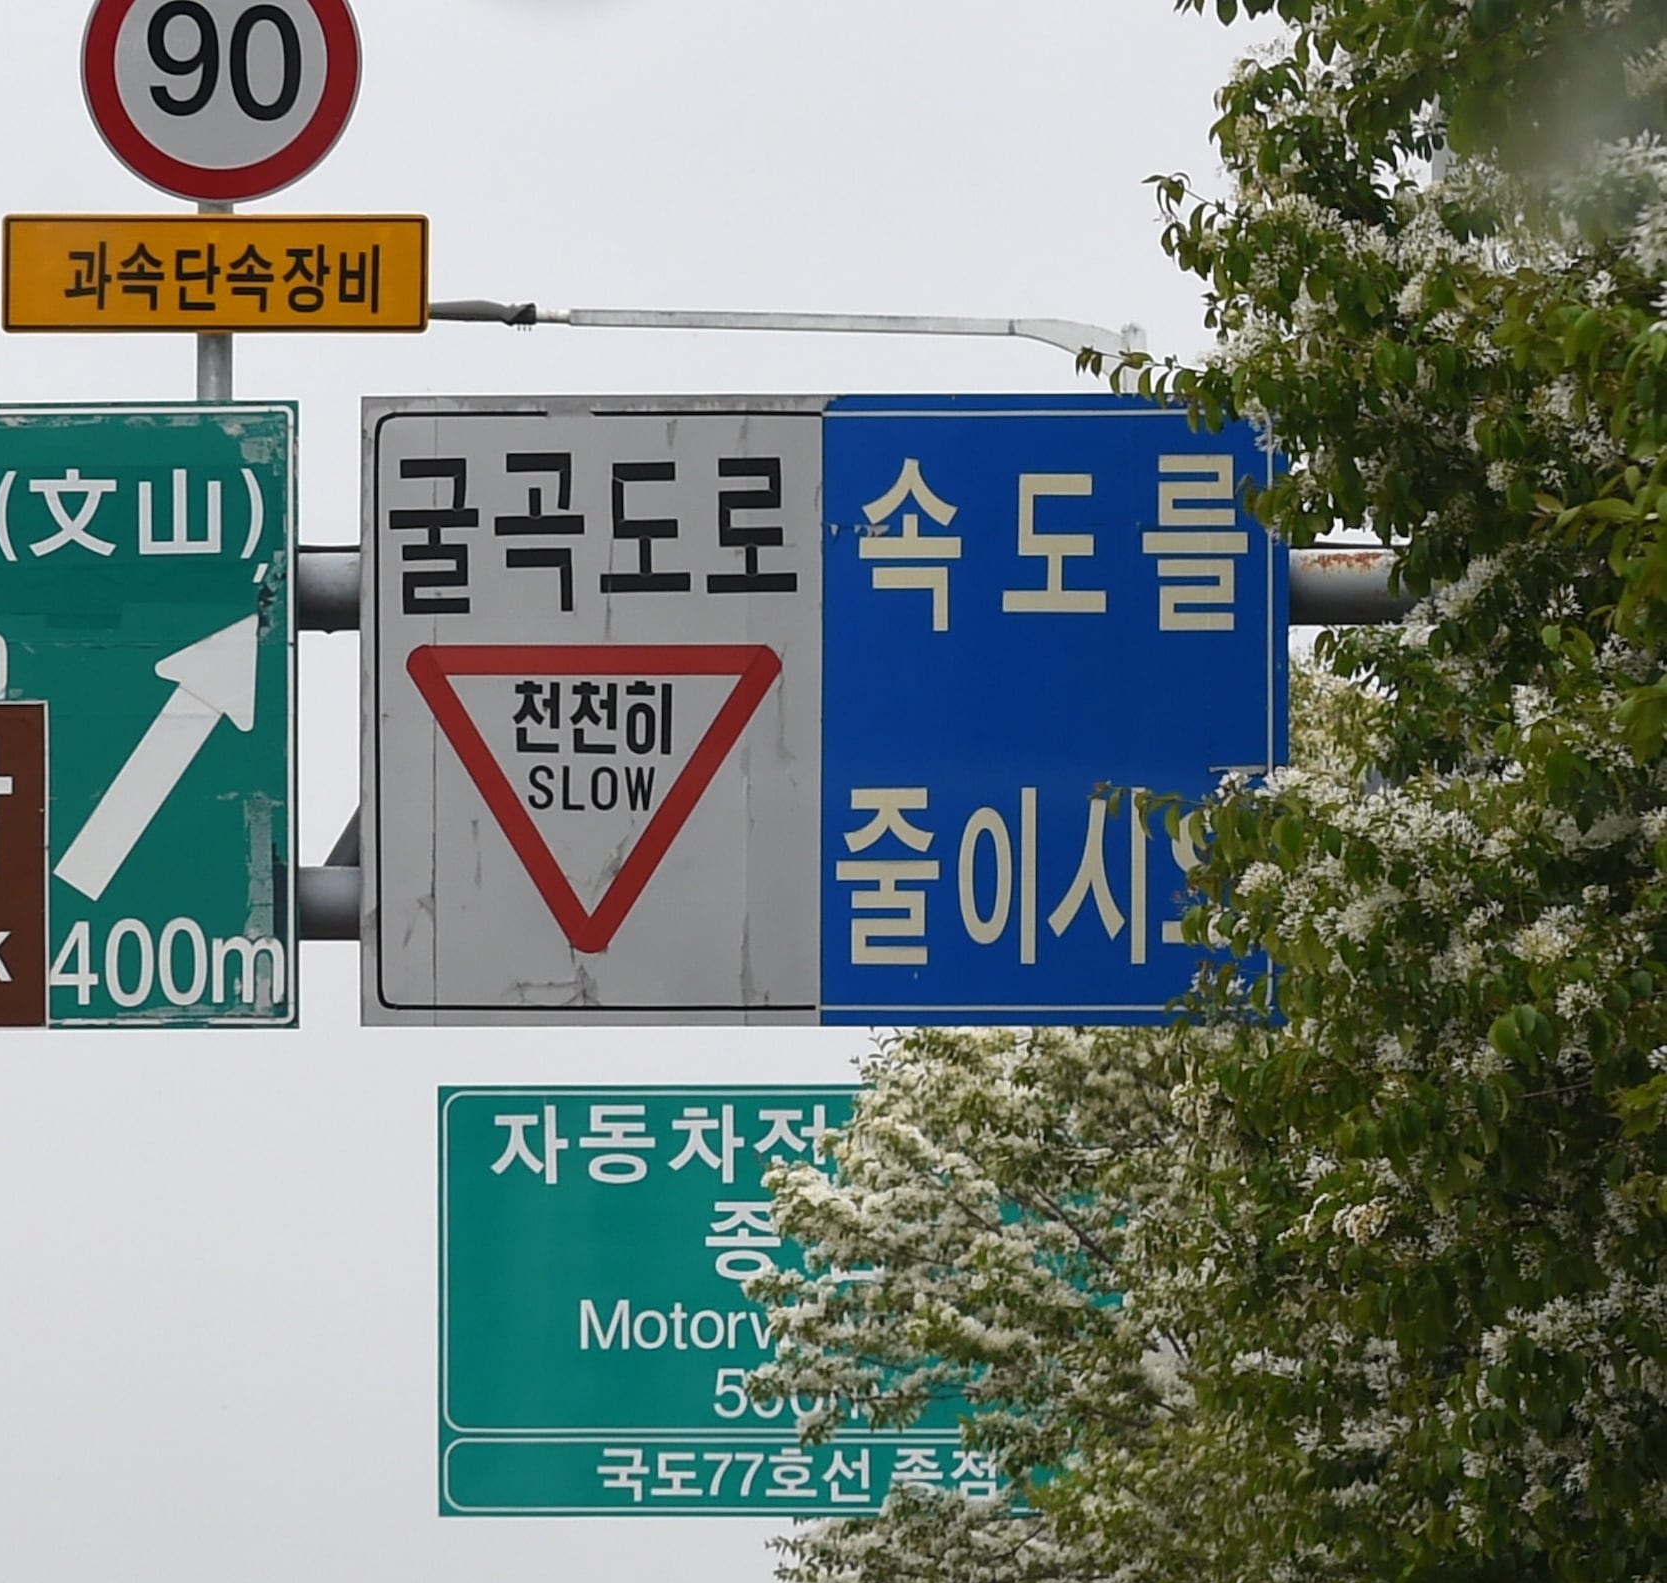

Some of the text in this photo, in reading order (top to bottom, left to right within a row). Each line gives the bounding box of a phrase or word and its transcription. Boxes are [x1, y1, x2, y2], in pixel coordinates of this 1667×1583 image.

[148, 0, 301, 121] 90
[65, 242, 379, 313] 과속단속장비
[389, 453, 798, 615] 굴곡도로
[858, 455, 1249, 632] 속도를
[513, 681, 672, 756] 천천히
[528, 764, 655, 812] SLOW
[49, 917, 285, 1006] 400m
[597, 1448, 871, 1503] 국도77호선
